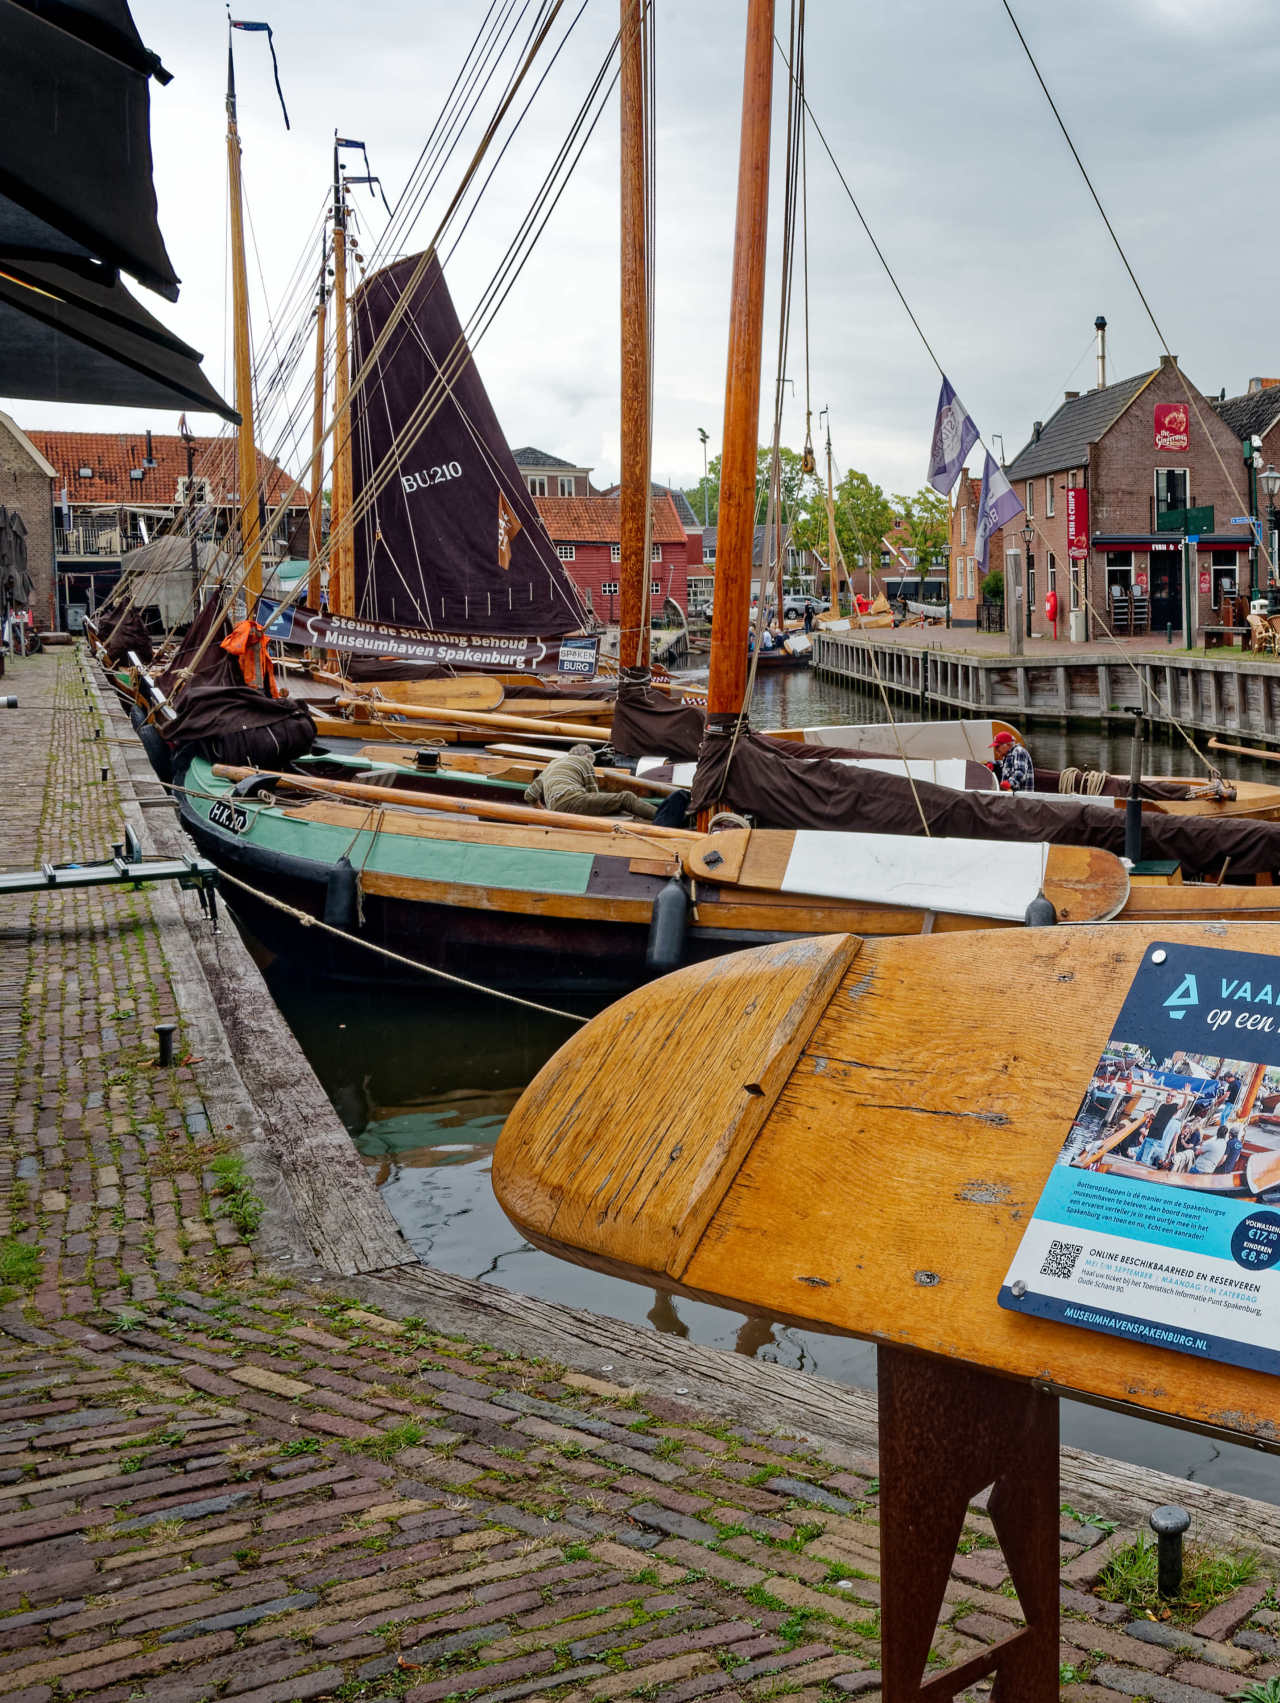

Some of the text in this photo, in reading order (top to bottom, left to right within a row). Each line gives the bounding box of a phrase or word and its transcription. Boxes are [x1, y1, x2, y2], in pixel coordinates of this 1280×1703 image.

[401, 461, 462, 494] BU.210
[330, 616, 375, 633] Steun
[324, 630, 526, 669] Museumhaven Spakenburg
[564, 661, 589, 671] BURG
[1206, 1008, 1232, 1031] op
[1234, 1012, 1275, 1032] een
[1066, 1207, 1101, 1220] Spakenburg
[1113, 1216, 1127, 1225] toen
[1147, 1223, 1161, 1231] Echt
[1174, 1229, 1205, 1241] aanrader!
[1243, 1241, 1272, 1254] KINDEREN
[1085, 1259, 1098, 1269] MEI
[1113, 1265, 1153, 1280] SEPTEMBER
[1161, 1275, 1201, 1291] MAANDAG
[1218, 1287, 1257, 1303] ZATERDAG
[1089, 1249, 1261, 1293] ONLINE BESCHIKBAARHEID EN RESERVEREN
[1081, 1268, 1095, 1278] Haal
[1105, 1272, 1122, 1282] ticket
[1123, 1275, 1131, 1285] bij
[1132, 1278, 1142, 1287] het
[1142, 1280, 1174, 1296] Toeristisch
[1175, 1288, 1207, 1302] Informatie
[1208, 1296, 1222, 1306] Punt
[1223, 1298, 1262, 1317] Spakenburg,
[1064, 1307, 1208, 1351] MUSEUMHAVENSPAKENBURG.NL
